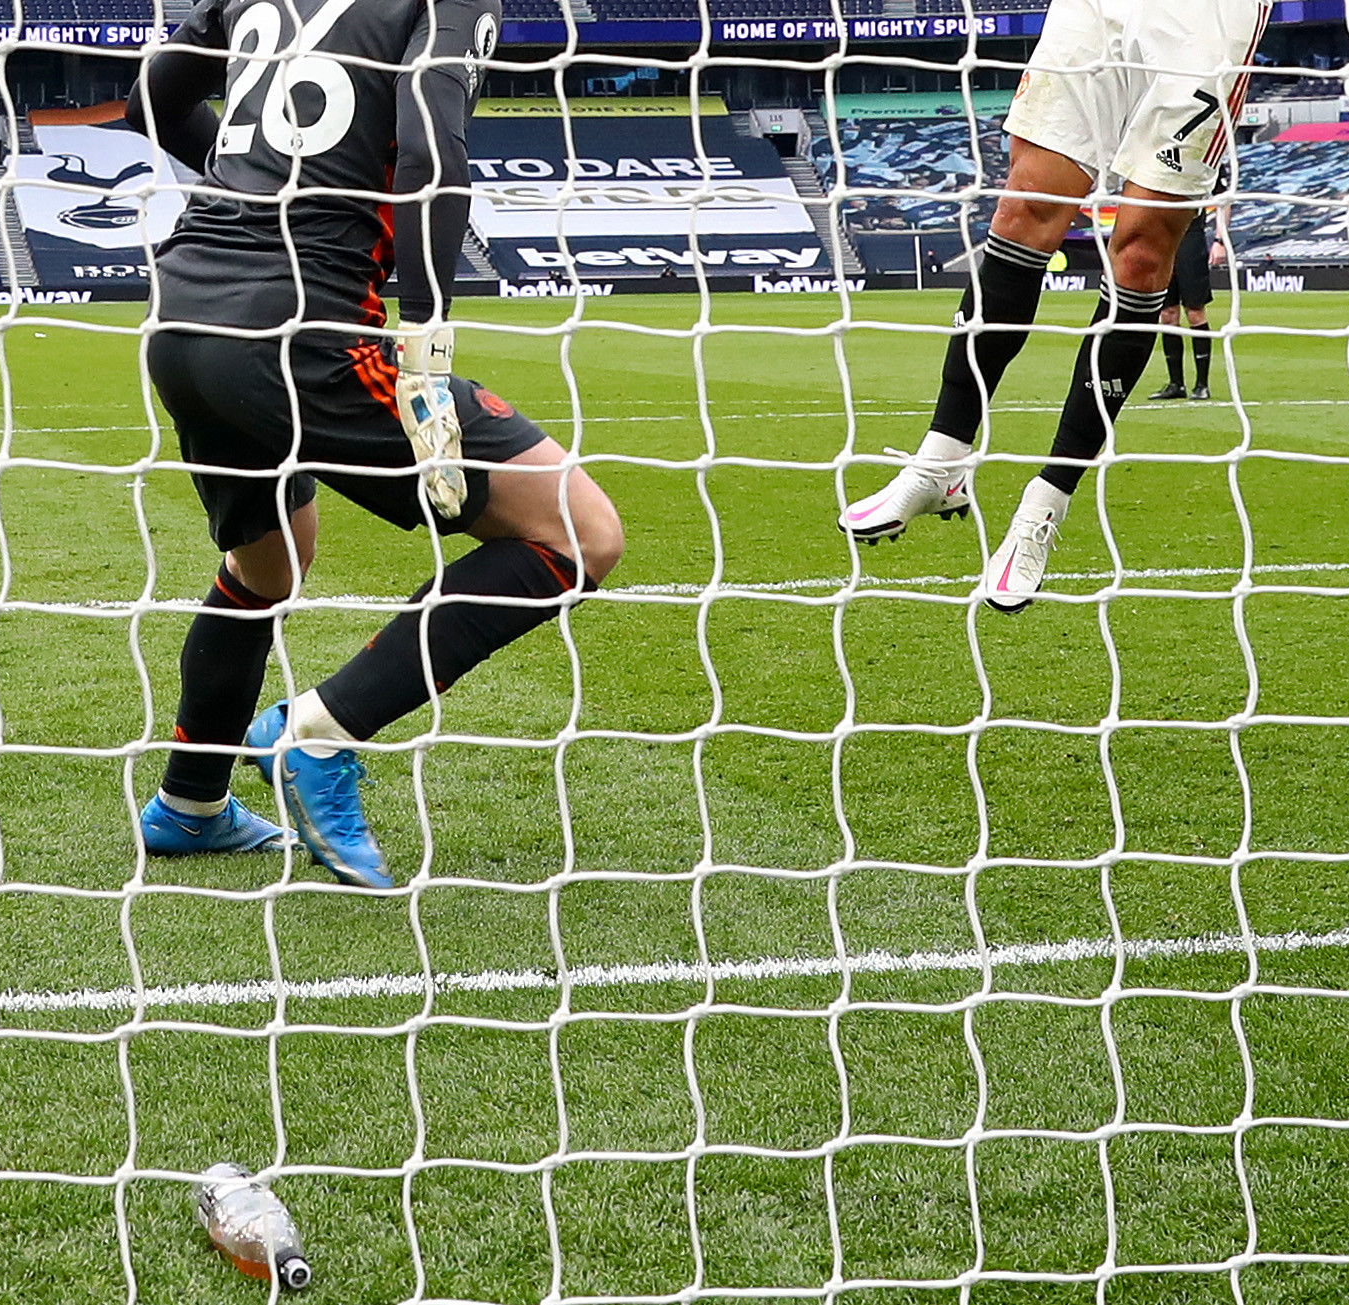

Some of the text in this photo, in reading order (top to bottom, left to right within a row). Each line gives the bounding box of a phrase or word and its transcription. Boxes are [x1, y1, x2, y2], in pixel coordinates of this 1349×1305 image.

[25, 26, 101, 43] MIGHTY
[106, 26, 170, 43] SPURS
[723, 21, 777, 39] HOME
[782, 21, 807, 38] OF
[854, 19, 928, 38] MIGHTY
[933, 17, 996, 36] SPURS
[574, 105, 620, 113] ONE
[623, 105, 676, 113] TEAM
[1173, 89, 1220, 142] 7
[468, 156, 743, 178] TO DARE
[517, 246, 822, 269] betway
[1245, 269, 1304, 292] betway
